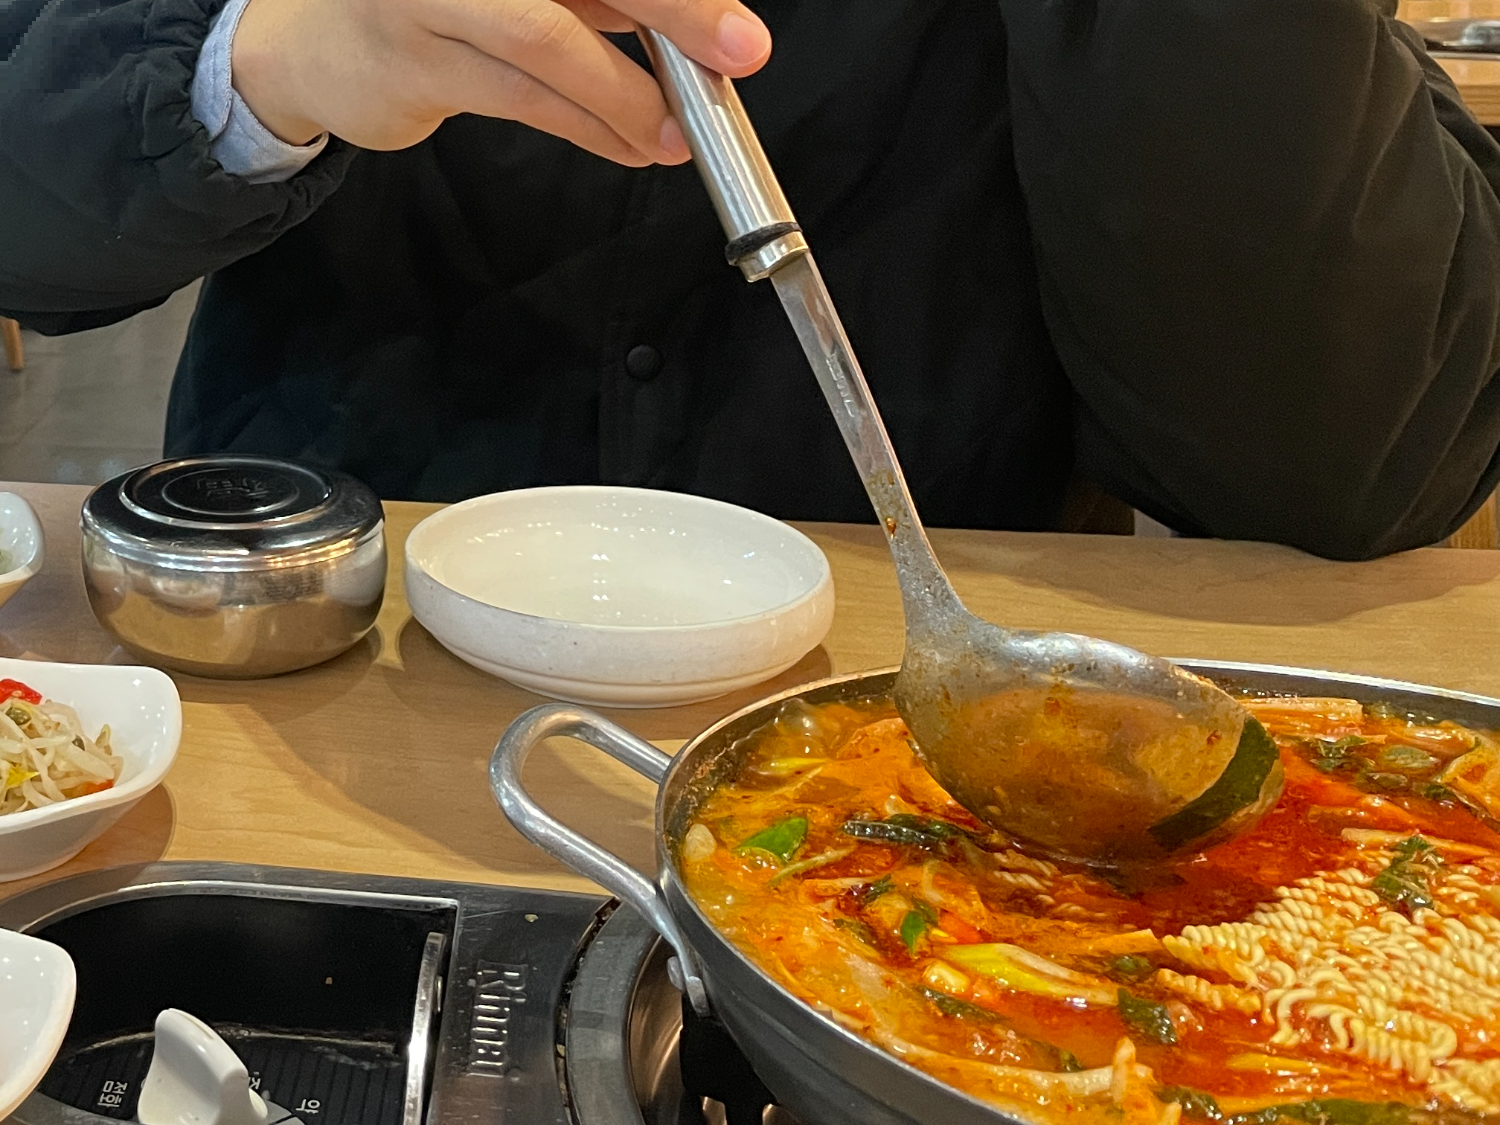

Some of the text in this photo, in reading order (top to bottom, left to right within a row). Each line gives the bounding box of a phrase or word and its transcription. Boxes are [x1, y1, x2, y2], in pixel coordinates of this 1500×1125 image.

[466, 960, 528, 1081] Rinnai
[98, 1077, 129, 1107] 점화
[295, 1098, 321, 1116] 약
